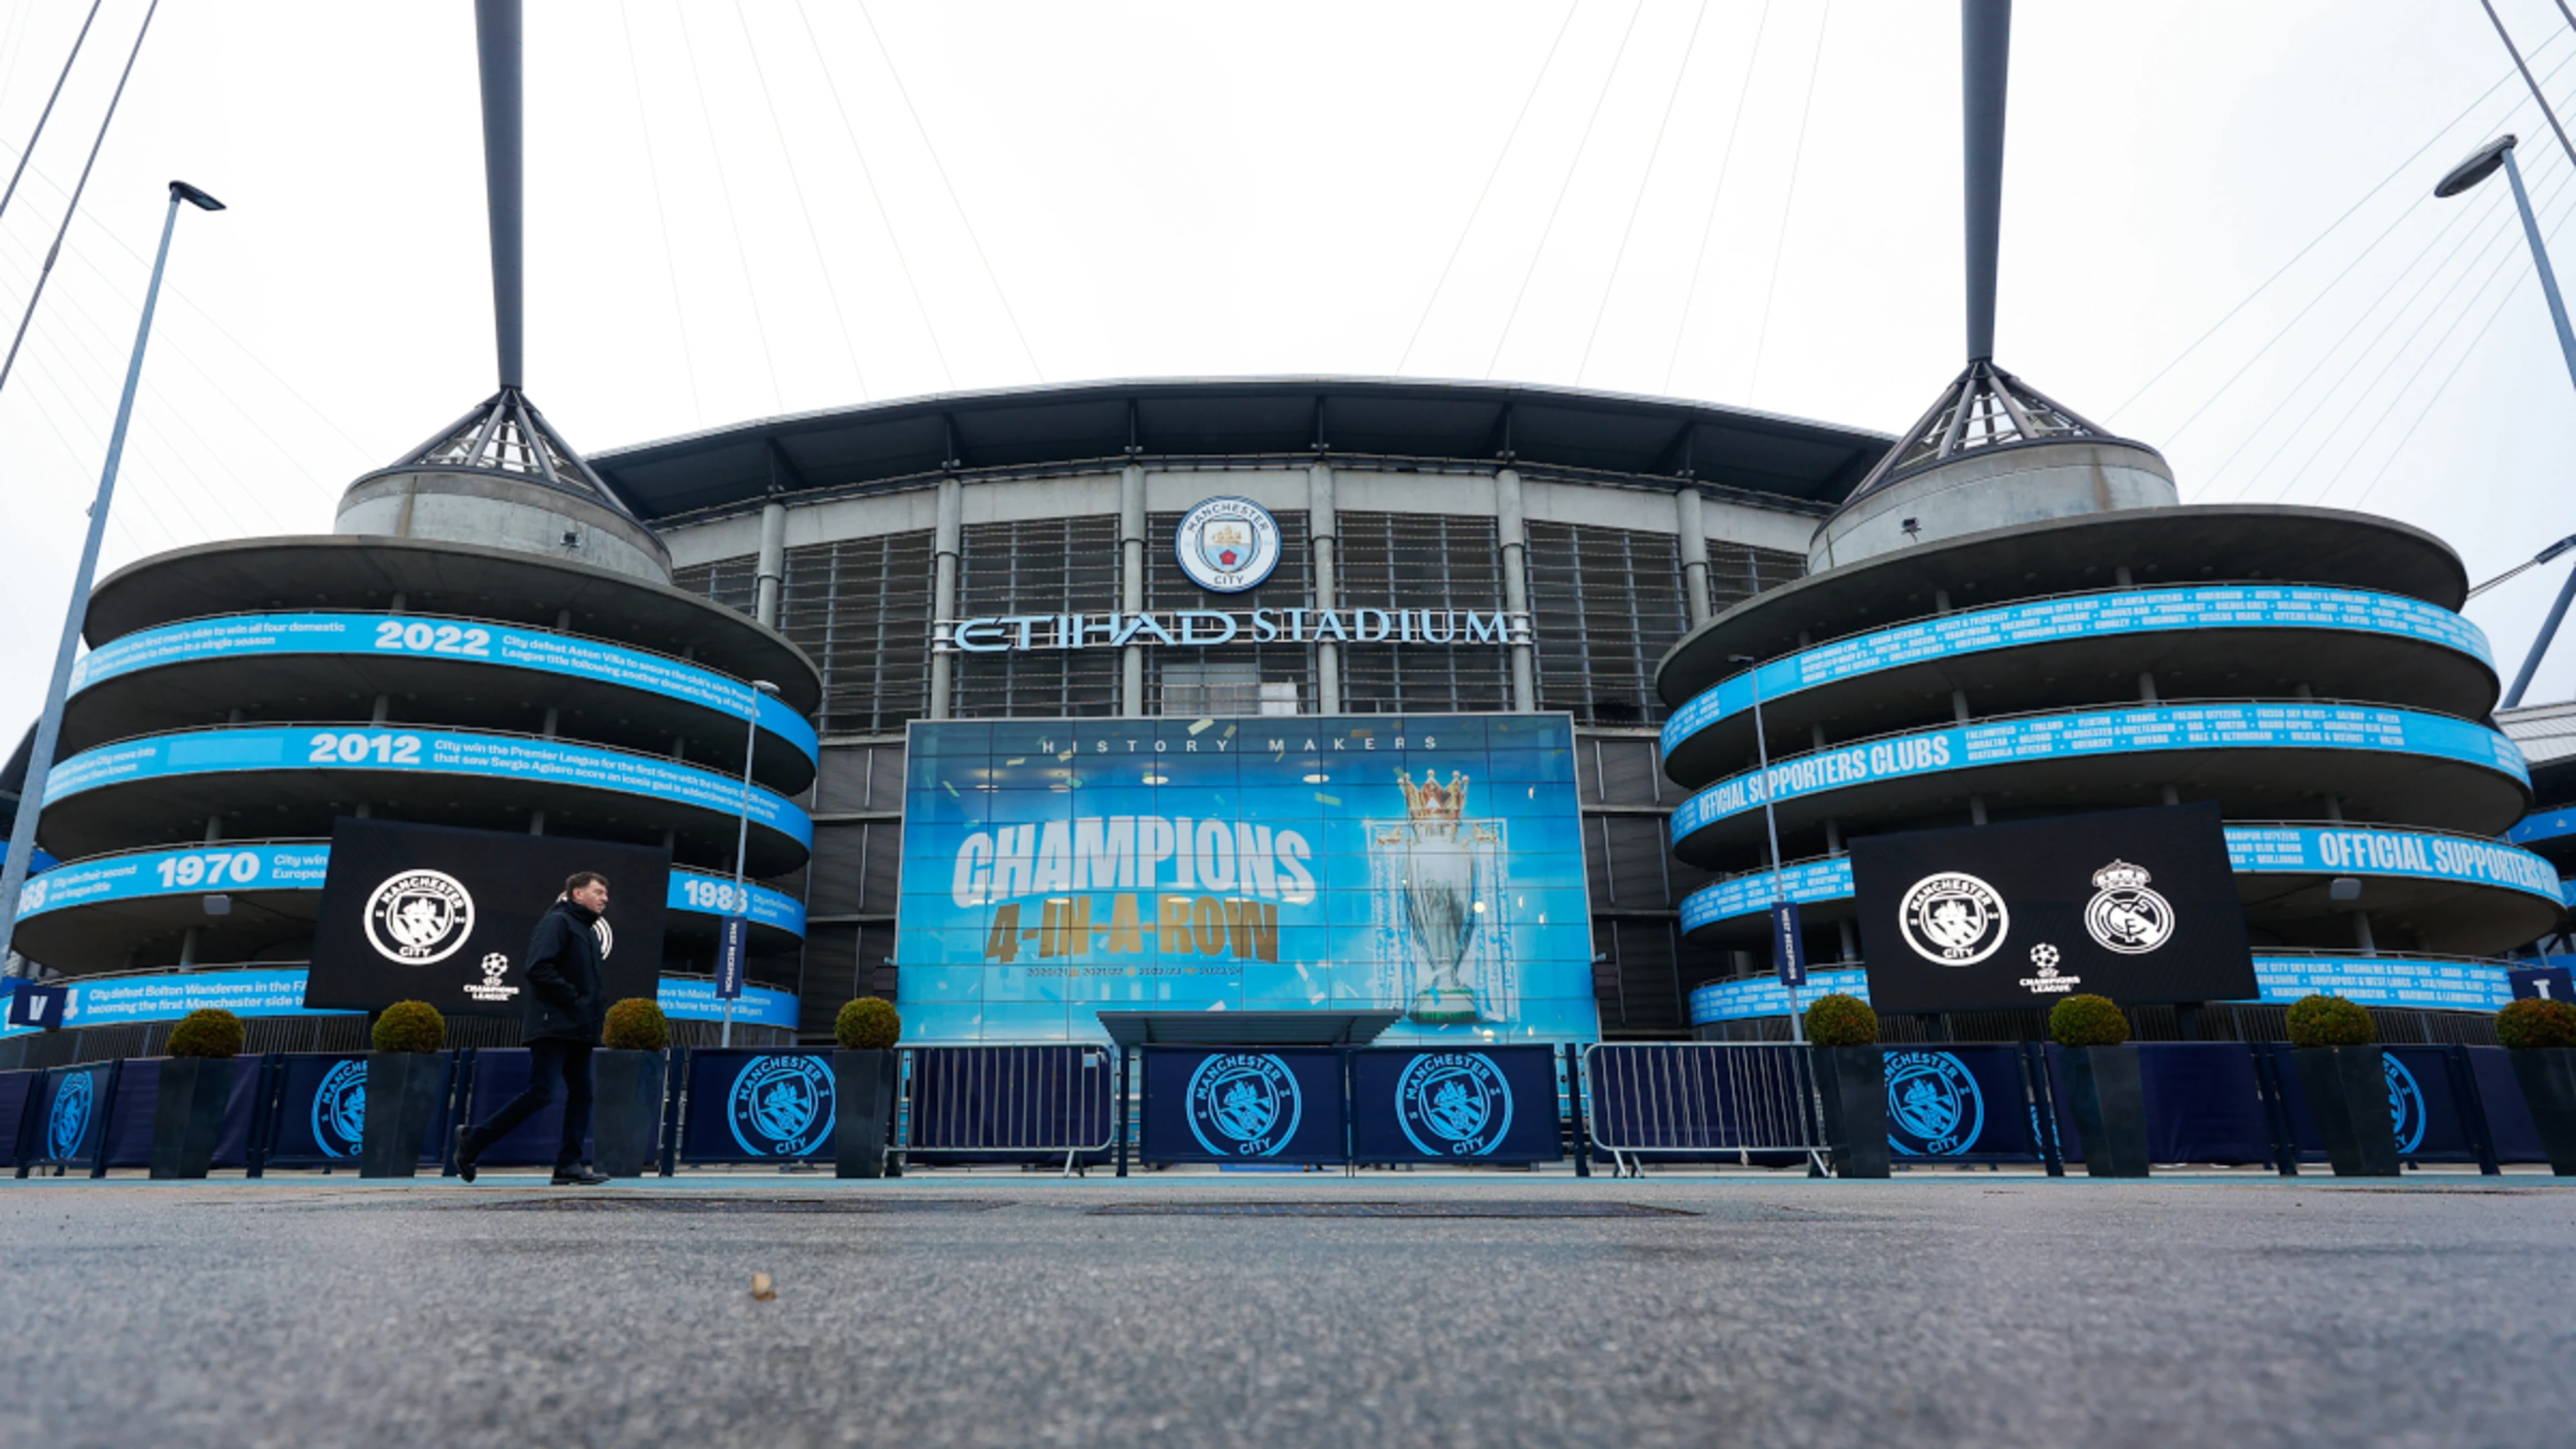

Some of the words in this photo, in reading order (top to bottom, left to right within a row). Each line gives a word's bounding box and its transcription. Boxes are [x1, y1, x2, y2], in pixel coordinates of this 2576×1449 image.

[1187, 504, 1269, 532] MANCHESTER
[1214, 575, 1244, 584] CITY
[234, 637, 276, 646] season
[264, 623, 287, 632] four
[288, 623, 345, 632] domestic
[375, 621, 490, 657] 2022
[955, 610, 1236, 651] ETIHAD
[1252, 607, 1509, 645] STADIUM
[502, 635, 528, 648] City
[530, 640, 566, 654] defeat
[568, 645, 601, 659] Aston
[603, 652, 625, 666] Villa
[627, 659, 638, 668] to
[502, 647, 545, 663] League
[547, 654, 569, 666] title
[571, 658, 621, 677] following
[2030, 720, 2063, 732] FINLAND
[2126, 712, 2157, 723] FRANCE
[309, 733, 421, 764] 2012
[435, 740, 462, 753] City
[463, 741, 486, 753] win
[488, 744, 508, 755] the
[511, 746, 558, 761] Premier
[560, 751, 599, 767] League
[601, 757, 616, 769] for
[618, 761, 633, 771] the
[1042, 739, 1228, 753] HISTORY
[1269, 737, 1437, 753] MAKERS
[434, 751, 460, 763] that
[462, 755, 487, 765] saw
[490, 757, 529, 771] Sergio
[532, 761, 573, 775] Agüero
[575, 767, 606, 780] score
[607, 773, 621, 782] an
[1699, 781, 1747, 822] OFFICIAL
[1749, 748, 1867, 804] SUPPORTERS
[1872, 735, 1950, 775] CLUBS
[157, 852, 260, 888] 1970
[274, 854, 301, 867] City
[303, 855, 327, 866] win
[952, 815, 1318, 910] CHAMPIONS
[2319, 832, 2433, 873] OFFICIAL
[2432, 838, 2542, 890] SUPPORTERS
[380, 877, 464, 908] MANCHESTER
[1910, 879, 1992, 911] MANCHESTER
[985, 894, 1279, 964] 4-IN-A-ROW
[399, 946, 433, 957] CITY
[1943, 947, 1974, 958] CITY
[146, 985, 183, 997] Bolton
[184, 983, 253, 995] Wanderers
[255, 981, 267, 992] in
[270, 981, 290, 992] the
[2019, 975, 2080, 987] CHAMPIONS
[87, 1002, 136, 1014] becoming
[138, 1000, 158, 1010] the
[159, 1000, 183, 1010] first
[185, 997, 263, 1009] Manchester
[264, 996, 292, 1006] side
[739, 1056, 823, 1101] MANCHESTER
[1196, 1054, 1282, 1099] MANCHESTER
[1406, 1053, 1491, 1100] MANCHESTER
[1452, 1135, 1485, 1155] CITY
[775, 1136, 806, 1155] CITY
[1238, 1136, 1272, 1155] CITY
[1927, 1134, 1960, 1153] CITY
